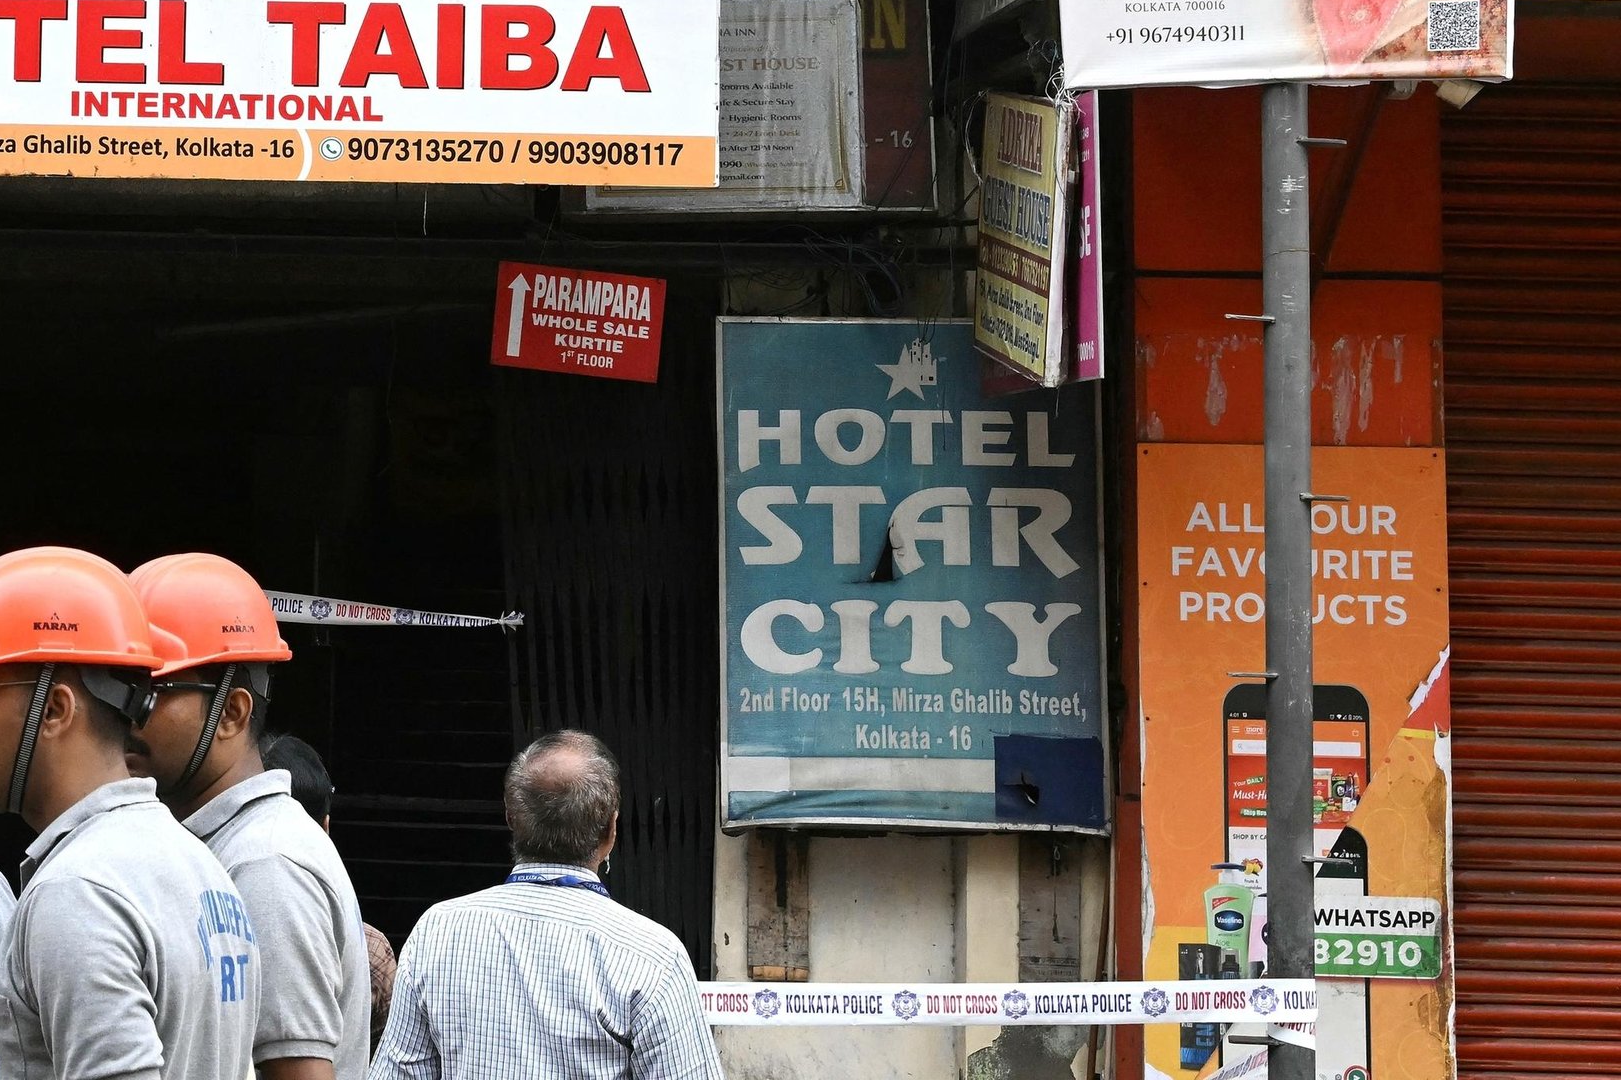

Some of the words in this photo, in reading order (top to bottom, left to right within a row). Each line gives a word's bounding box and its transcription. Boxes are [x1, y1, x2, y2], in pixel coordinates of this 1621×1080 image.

[1124, 2, 1182, 14] KOLKATA
[1184, 0, 1226, 12] 700016
[267, 0, 652, 93] TAIBA
[1105, 27, 1134, 44] +91
[1140, 24, 1246, 43] 9674940311
[752, 56, 819, 71] HOUSE
[71, 91, 384, 122] INTERNATIONAL
[770, 114, 802, 122] Rooms
[23, 134, 92, 156] Ghalib
[98, 136, 169, 159] Street,
[176, 137, 255, 159] Kolkata
[348, 138, 504, 164] 9073135270
[528, 140, 685, 167] 9903908117
[532, 273, 651, 322] PARAMPARA
[532, 313, 598, 333] WHOLE
[602, 321, 650, 339] SALE
[555, 333, 624, 353] KURTIE
[577, 353, 614, 369] FLOOR
[737, 408, 1077, 474] HOTEL
[1185, 502, 1265, 533] ALL
[1311, 504, 1397, 535] OUR
[736, 485, 1081, 580] STAR
[1171, 546, 1414, 581] FAVRITE
[272, 597, 303, 614] POLICE
[348, 604, 364, 620] NOT
[365, 606, 391, 622] CROSS
[1180, 591, 1407, 626] PROUCTS
[33, 622, 78, 632] KARAM
[222, 624, 255, 634] KARAM
[740, 599, 1082, 678] CITY
[739, 686, 774, 713] 2nd
[781, 687, 830, 713] Floor
[842, 687, 886, 718] 15H,
[892, 687, 944, 713] Mirza
[951, 688, 1013, 715] Ghalib
[1019, 689, 1086, 722] Street,
[855, 724, 930, 751] Kolkata
[949, 725, 972, 751] 16
[1216, 916, 1243, 924] Vaseline
[1314, 909, 1436, 929] WHATSAPP
[1314, 938, 1423, 967] 82910
[717, 993, 749, 1013] CROSS
[786, 994, 840, 1014] KOLKATA
[843, 994, 883, 1014] POLICE
[943, 994, 962, 1014] NOT
[965, 994, 998, 1014] CROSS
[1034, 994, 1089, 1014] KOLKATA
[1092, 993, 1132, 1013] POLICE
[1192, 991, 1211, 1010] NOT
[1214, 990, 1246, 1010] CROSS
